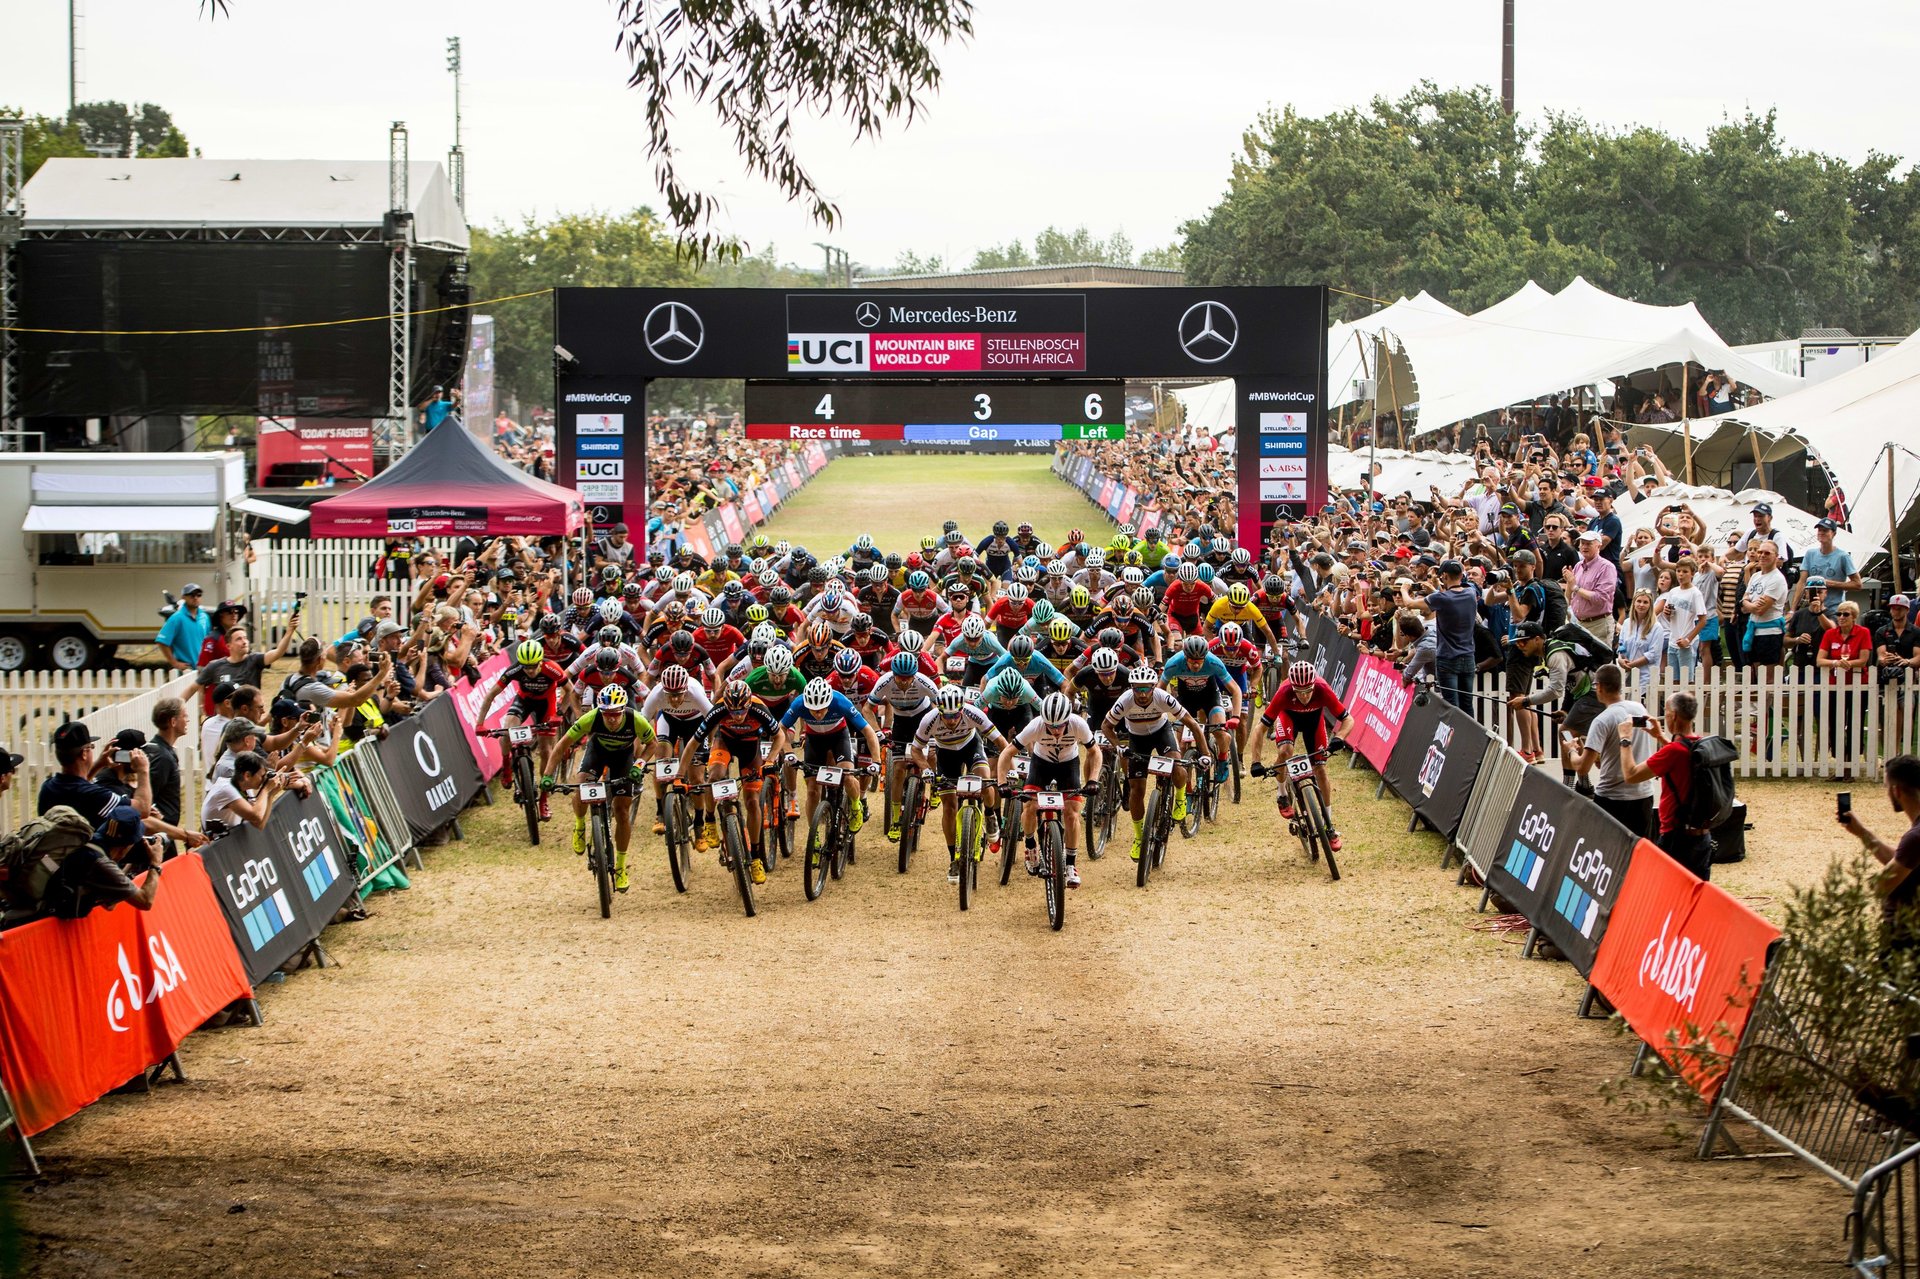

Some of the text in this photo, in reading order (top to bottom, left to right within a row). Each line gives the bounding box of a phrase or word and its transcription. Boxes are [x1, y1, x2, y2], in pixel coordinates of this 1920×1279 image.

[889, 306, 1017, 323] Mercedes-Benz
[875, 339, 975, 351] MOUNTAIN BIKE
[987, 338, 1079, 350] STELLENBOSCH
[803, 340, 863, 364] UCI
[987, 352, 1074, 365] SOUTH AFRICA
[875, 353, 950, 365] WORLD CUP
[565, 393, 632, 404] #MBWorldCup
[1249, 392, 1315, 403] #MBWorldCup
[814, 393, 835, 420] 4
[973, 393, 992, 421] 3
[1083, 393, 1103, 420] 6
[337, 427, 369, 438] FASTEST
[790, 425, 861, 438] Race time
[968, 426, 998, 440] Gap
[1080, 425, 1108, 438] Left
[587, 463, 619, 476] UCI
[1278, 464, 1303, 472] ABSA
[392, 521, 414, 530] UCI
[1359, 667, 1409, 726] STELLENBOSCH
[514, 730, 527, 739] 15
[663, 764, 672, 774] 6
[1017, 762, 1025, 771] 4
[1157, 761, 1165, 770] 7
[1290, 761, 1309, 774] 30
[824, 773, 832, 782] 2
[721, 785, 730, 794] 3
[966, 781, 972, 791] 1
[425, 775, 458, 811] OAKLEY
[589, 788, 597, 798] 8
[1046, 796, 1055, 804] 5
[1518, 803, 1556, 853] GoPro
[288, 815, 327, 864] GoPro
[1569, 837, 1613, 897] GoPro
[226, 856, 278, 910] GoPro
[1655, 935, 1708, 1014] ABSA
